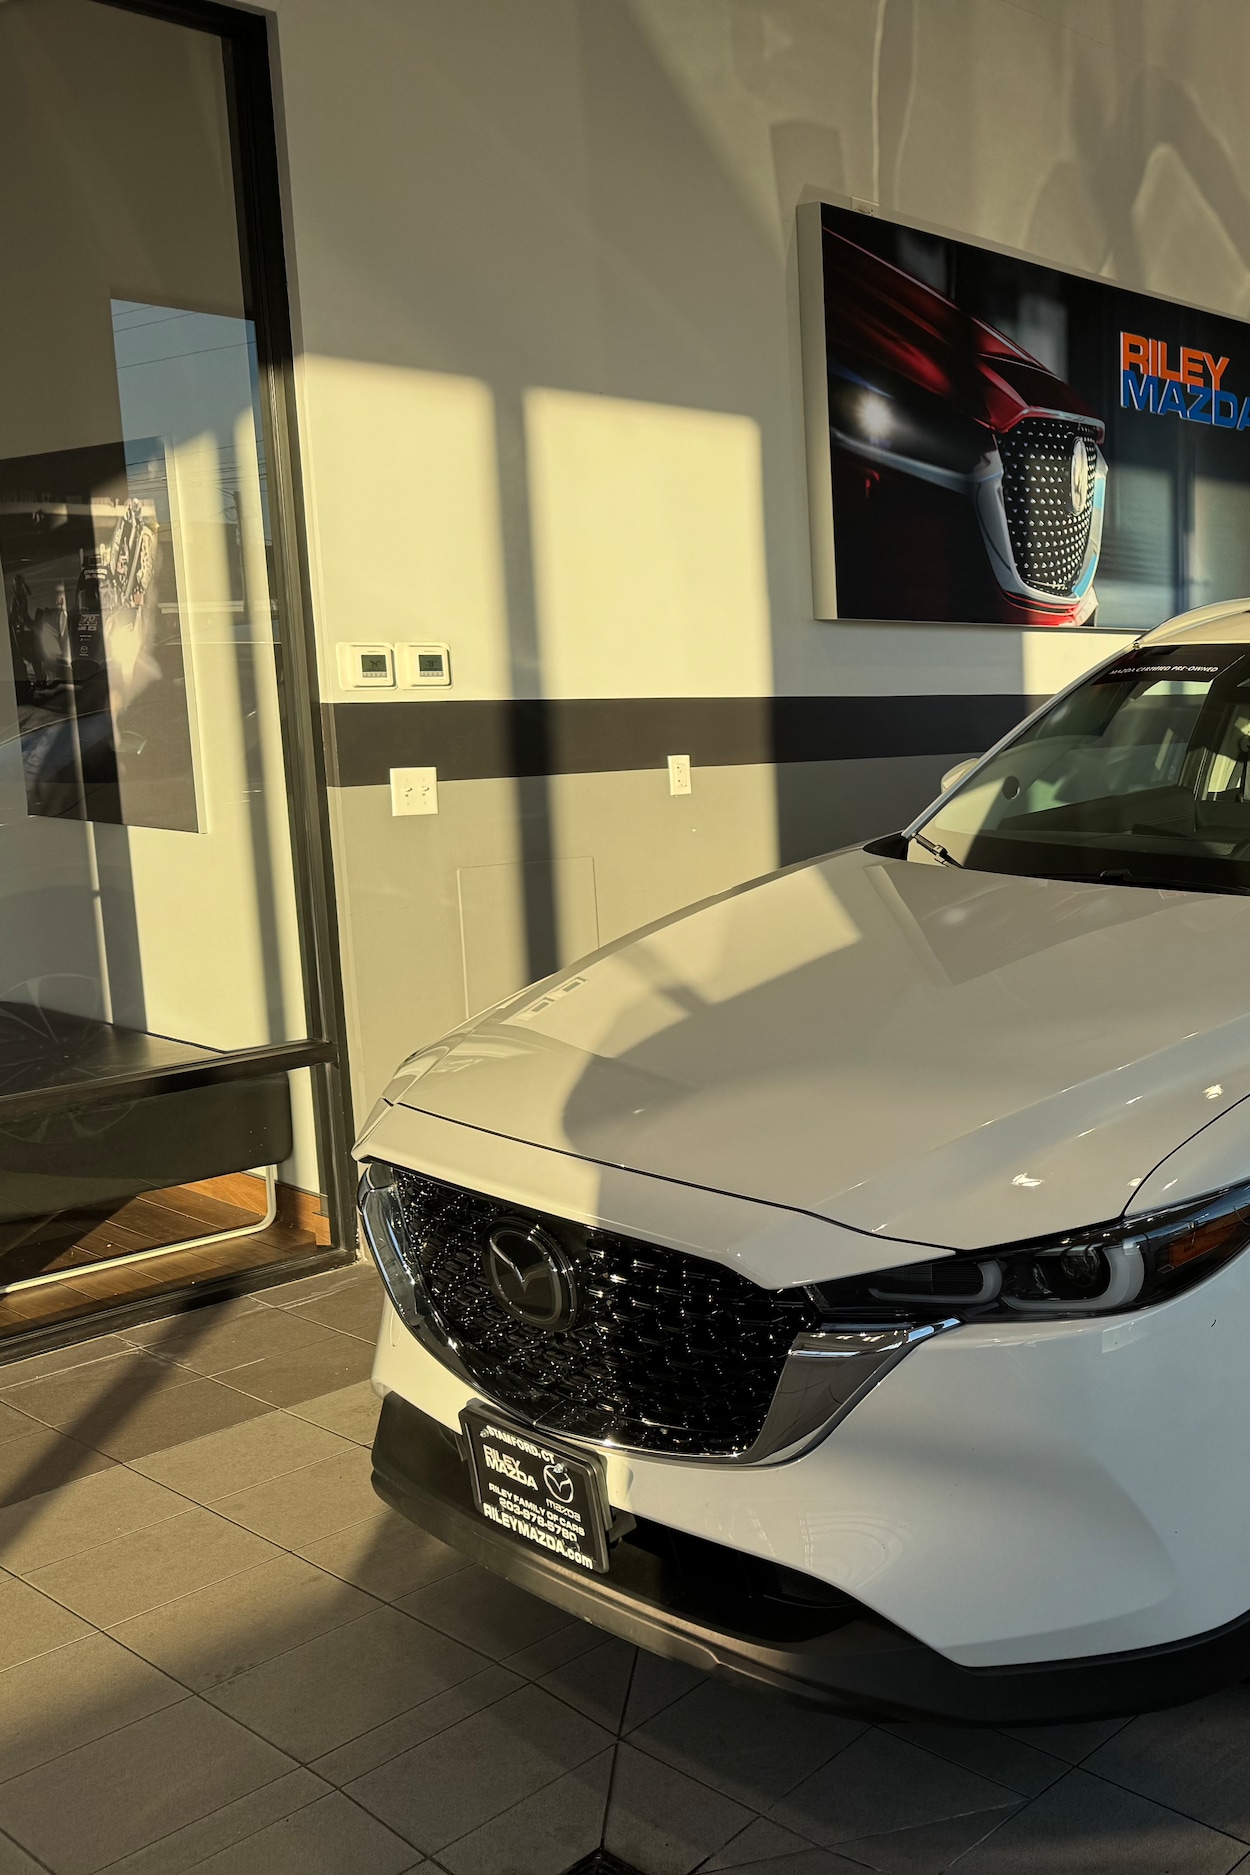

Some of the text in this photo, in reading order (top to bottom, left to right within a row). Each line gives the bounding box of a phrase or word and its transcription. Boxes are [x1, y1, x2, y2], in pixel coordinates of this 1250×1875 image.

[1120, 331, 1230, 391] RILEY
[483, 1444, 521, 1472] RILEY
[486, 1455, 539, 1491] MAZDA
[540, 1449, 555, 1465] CT
[488, 1482, 586, 1537] RILEY FAMILY OF CARS
[482, 1502, 594, 1570] RILEYMAZDA.com
